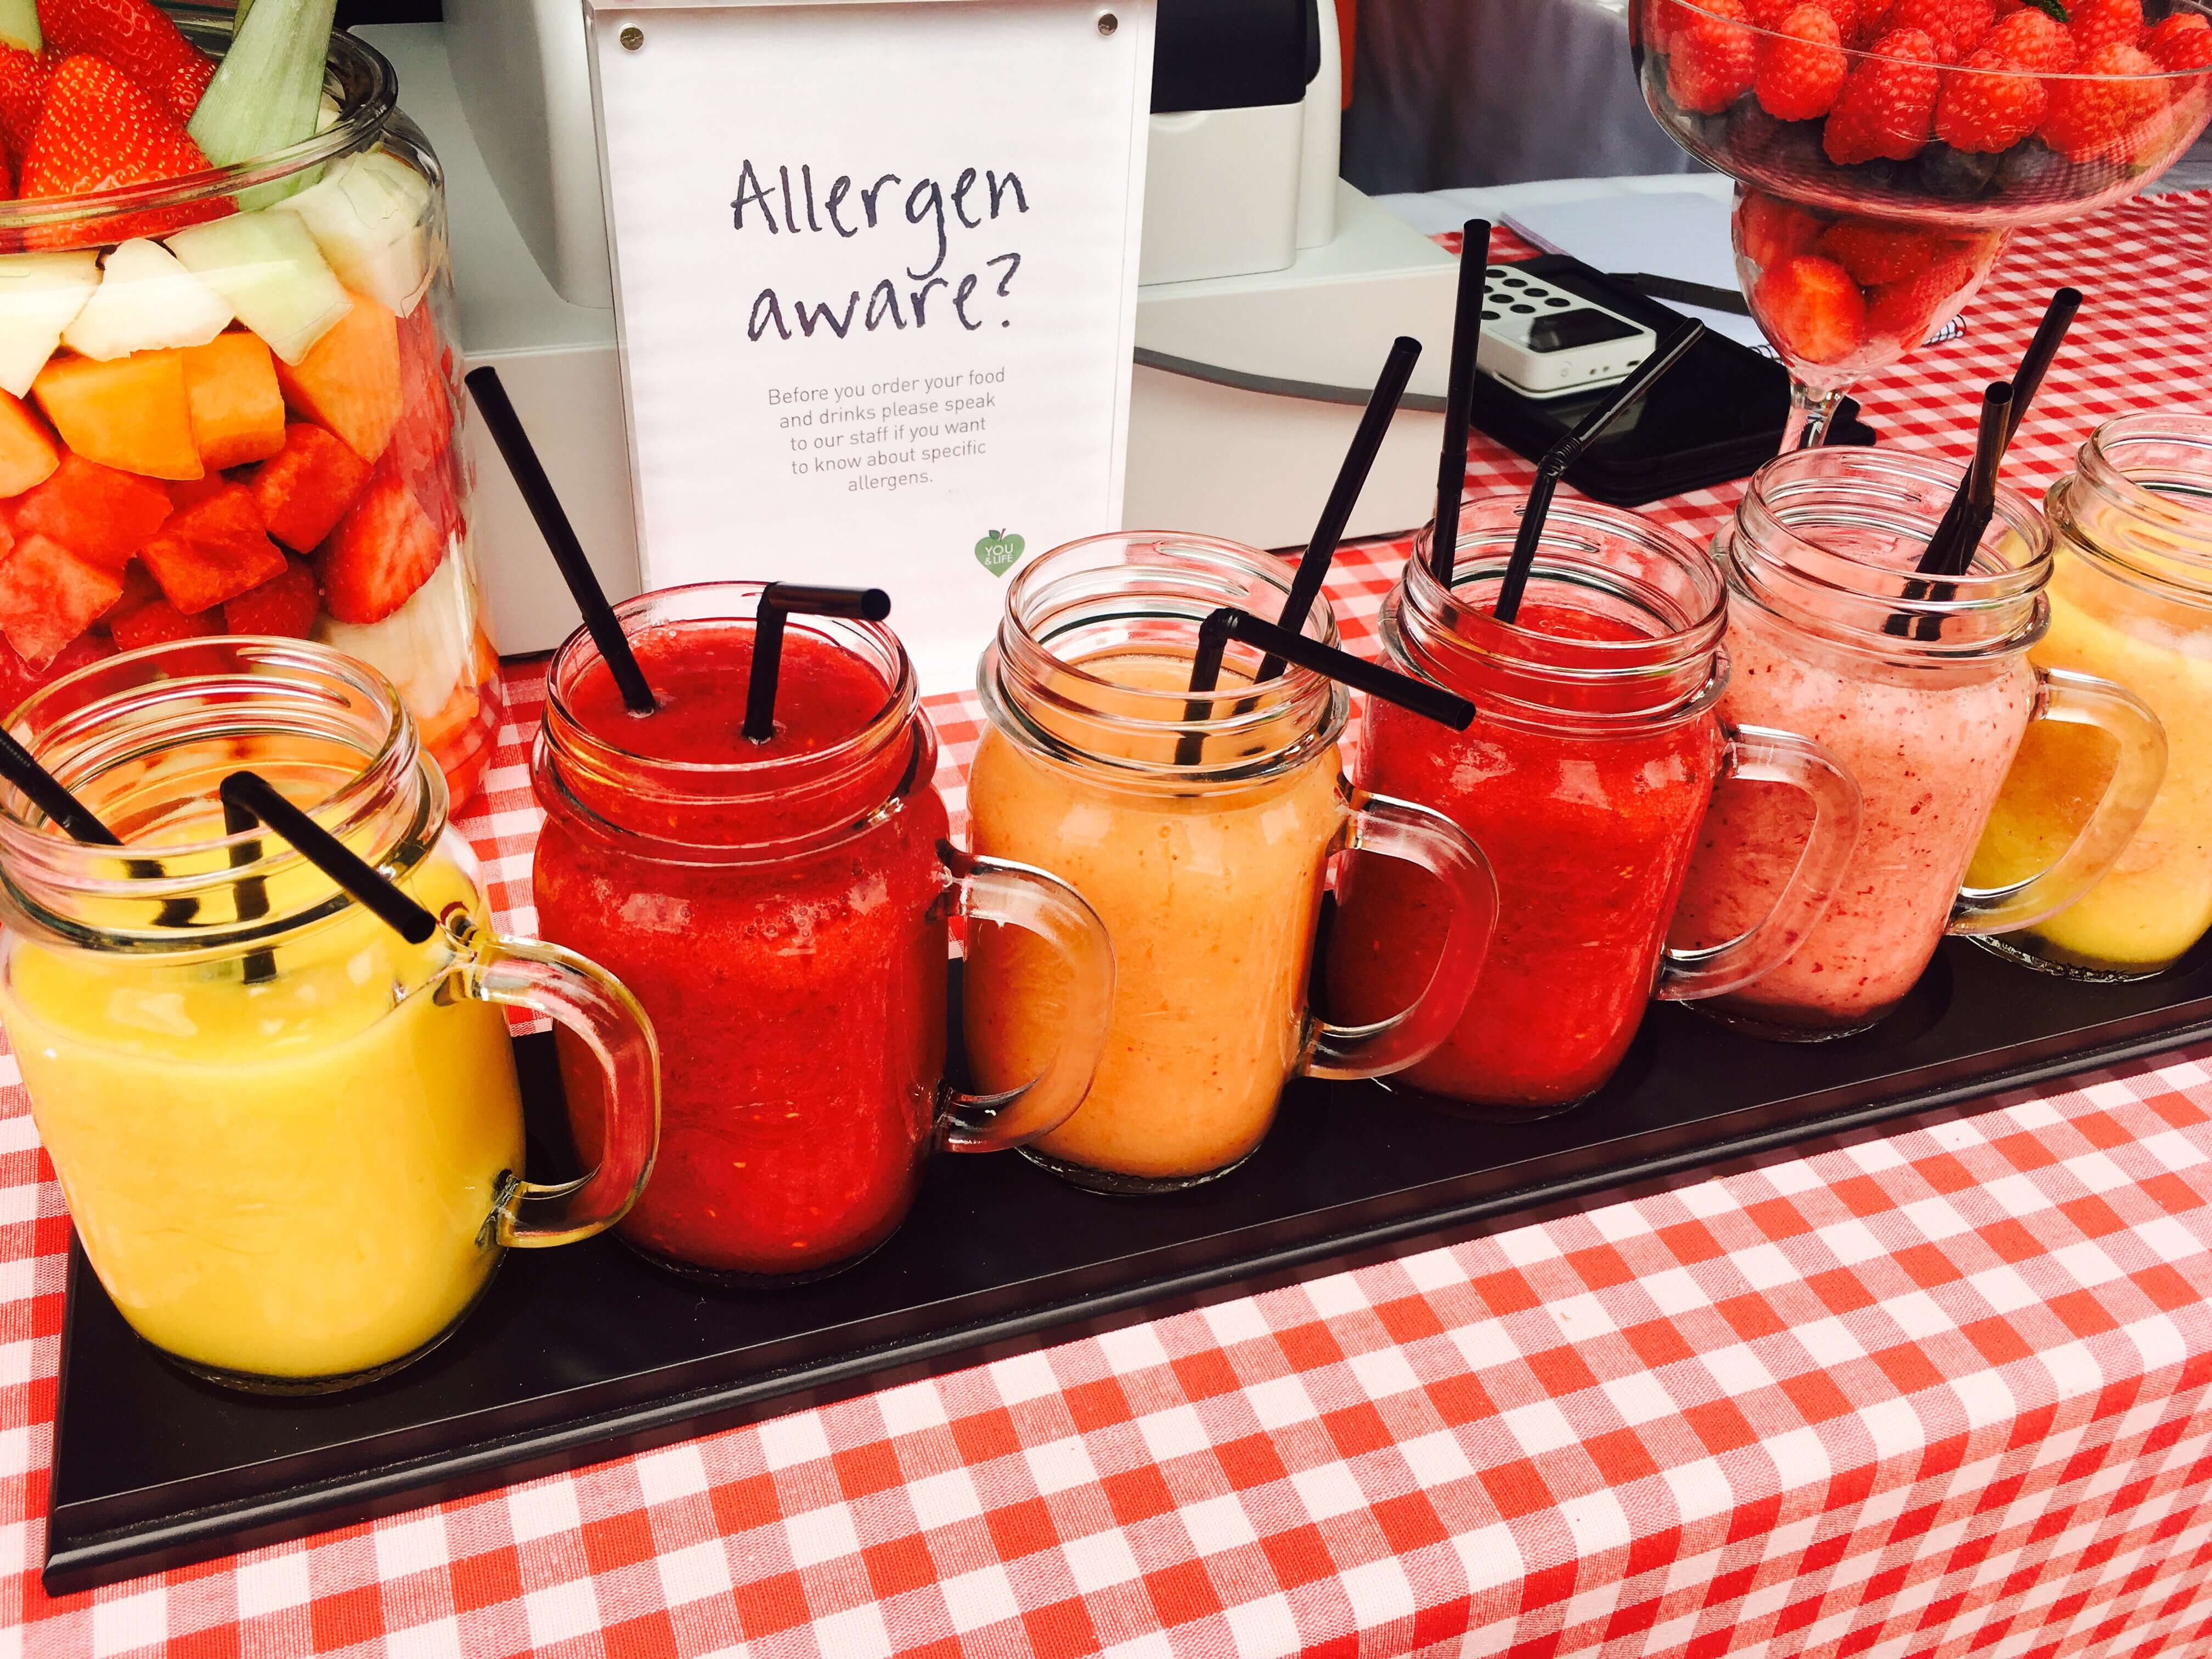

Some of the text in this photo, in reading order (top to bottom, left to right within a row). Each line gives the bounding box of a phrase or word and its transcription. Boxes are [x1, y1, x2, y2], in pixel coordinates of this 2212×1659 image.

[730, 160, 1029, 281] Allergen
[747, 253, 1021, 341] aware?
[768, 366, 1005, 405] Before you order your food
[780, 392, 995, 428] and drinks please speak
[791, 417, 986, 450] to our staff if you want
[792, 440, 986, 474] to know about specific
[848, 470, 933, 492] allergens.
[985, 543, 1013, 556] YOU
[994, 554, 1013, 564] LIFE
